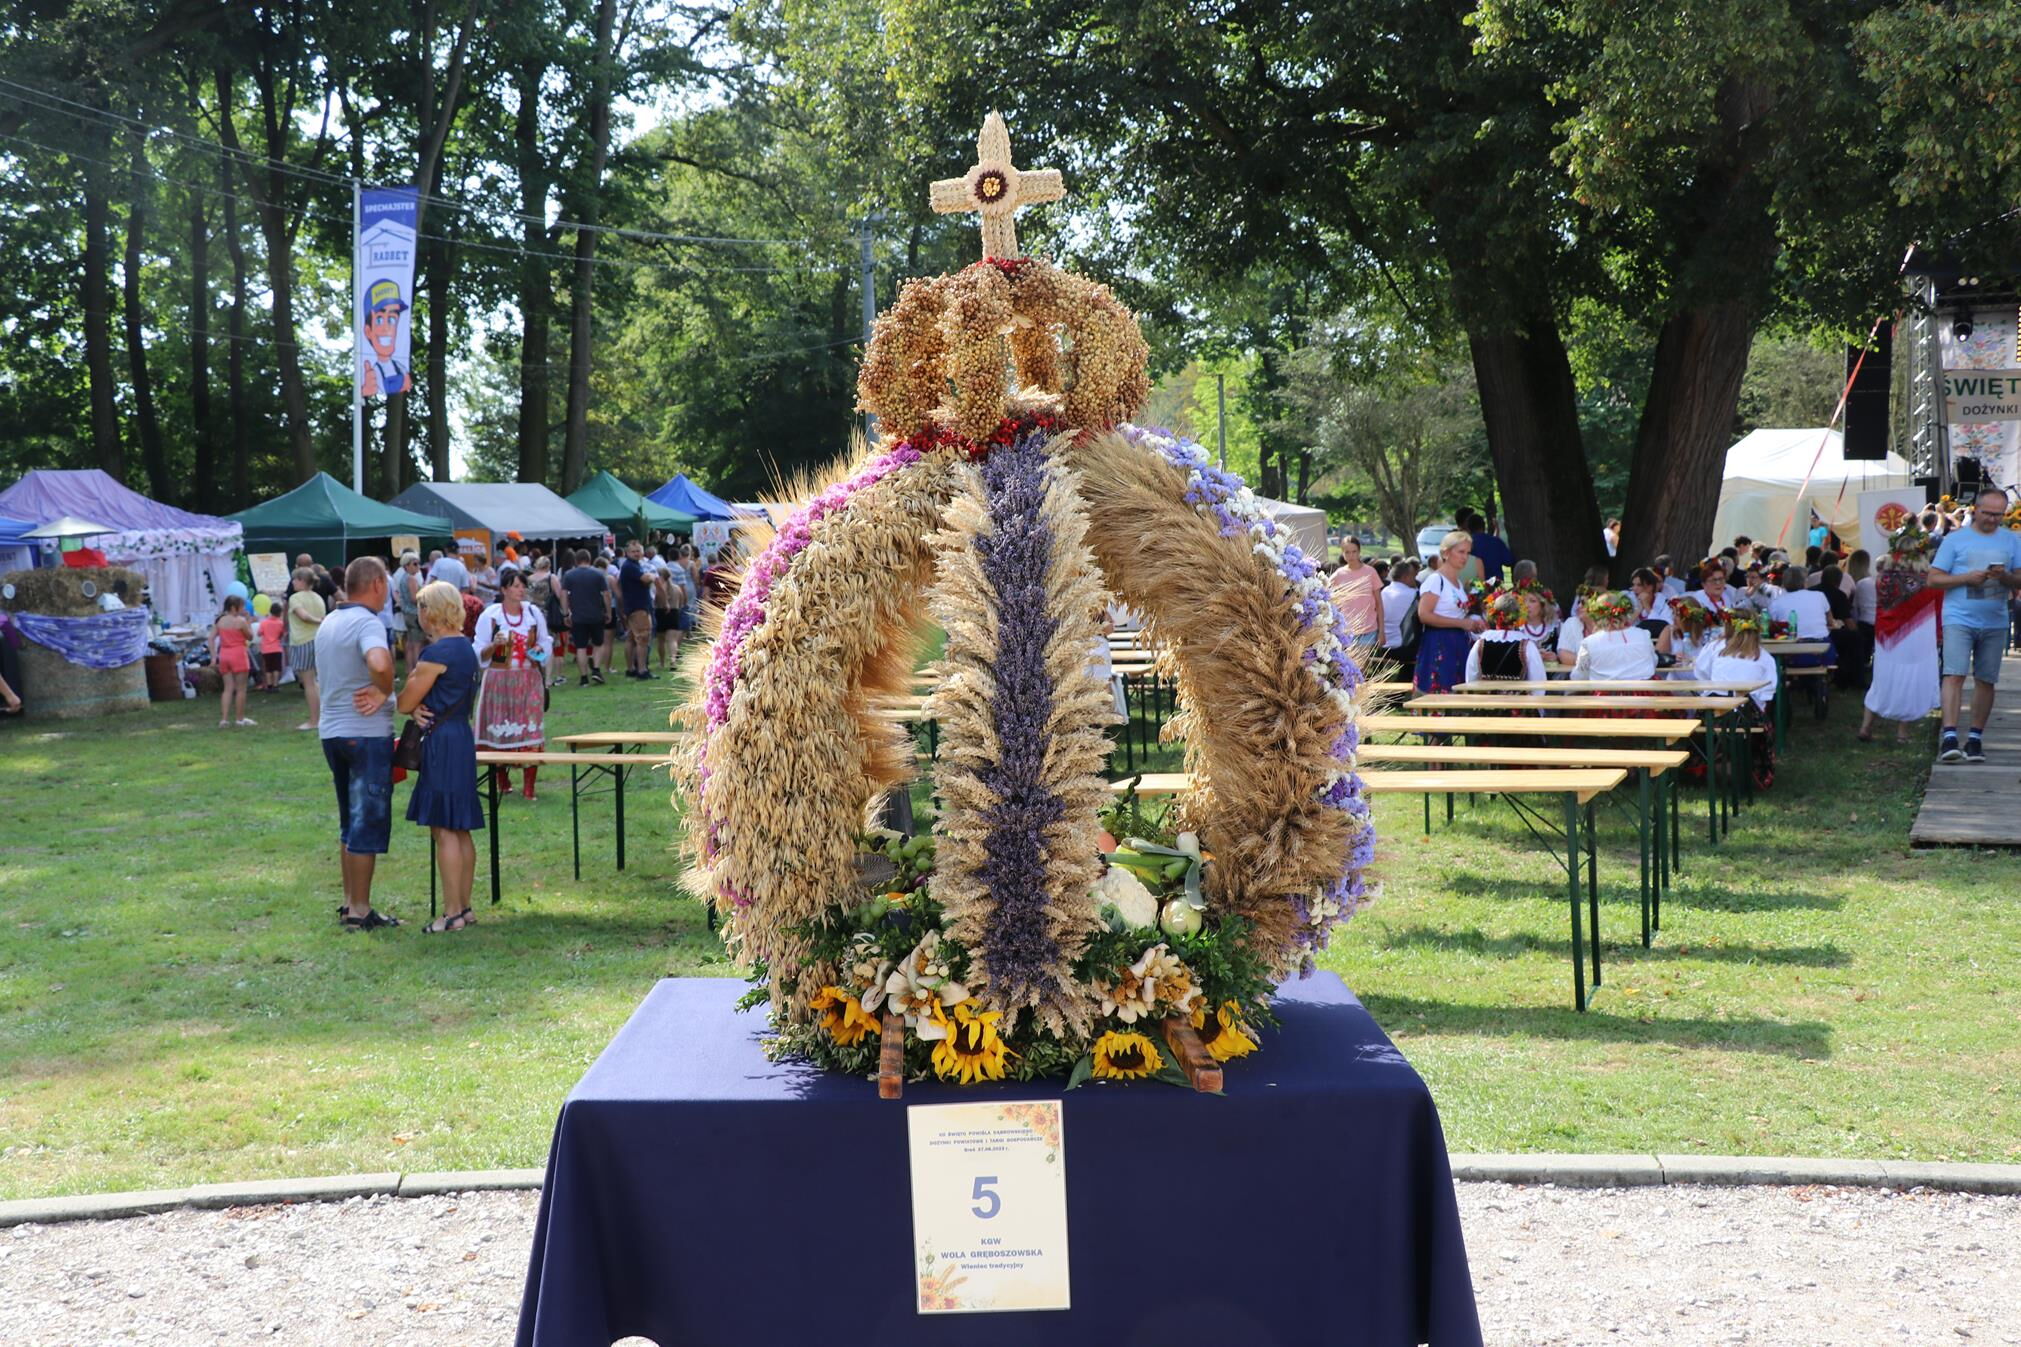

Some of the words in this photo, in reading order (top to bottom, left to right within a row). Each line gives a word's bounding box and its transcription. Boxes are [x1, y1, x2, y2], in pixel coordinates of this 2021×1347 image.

[1962, 403, 2018, 416] DOŻYNKI
[972, 1176, 1001, 1219] 5
[941, 1251, 966, 1259] WOLA
[970, 1249, 1043, 1259] GRĘBOSZOWSKA
[989, 1262, 1024, 1270] tradycyjny
